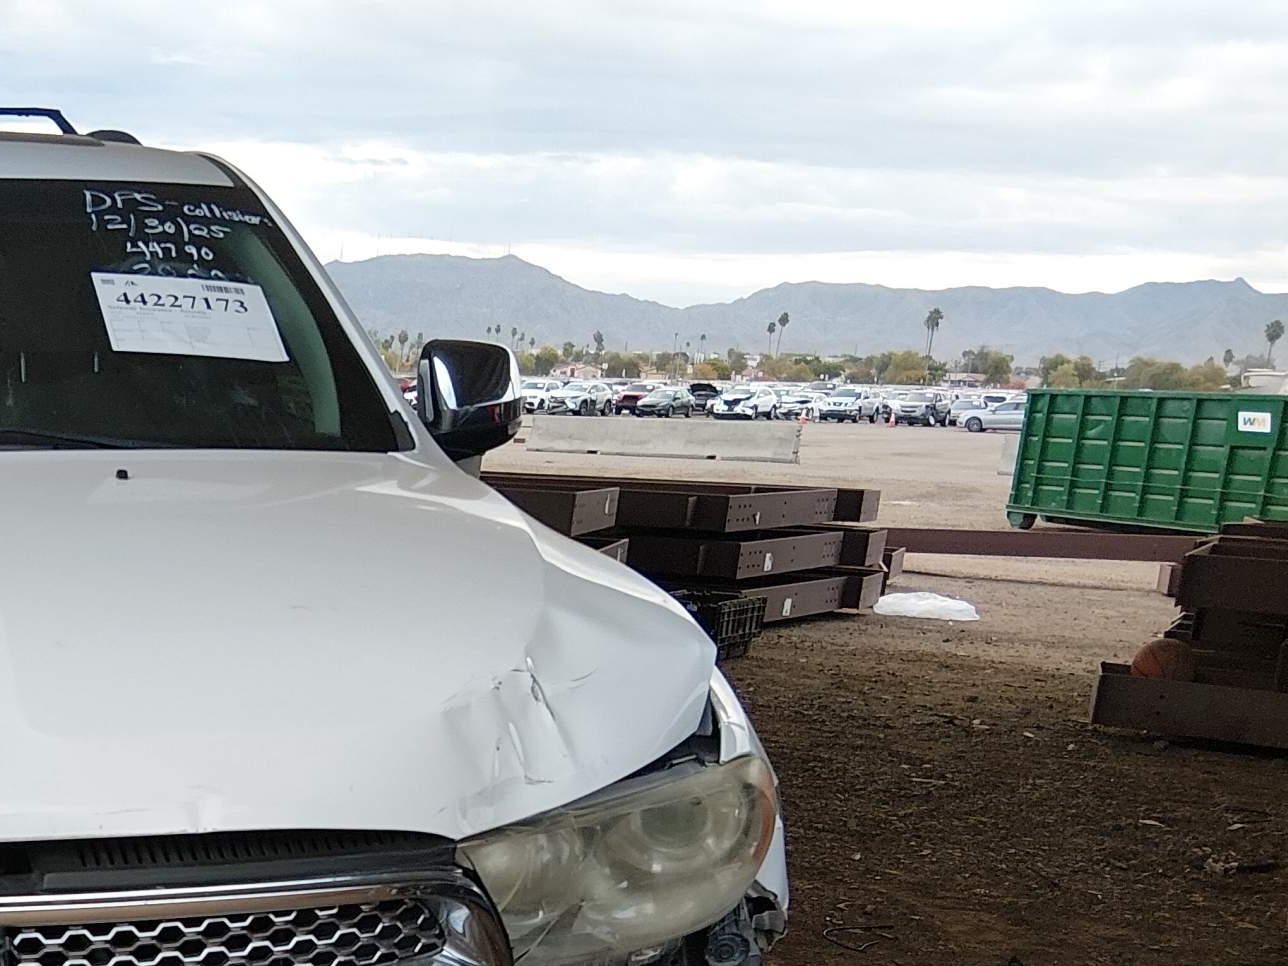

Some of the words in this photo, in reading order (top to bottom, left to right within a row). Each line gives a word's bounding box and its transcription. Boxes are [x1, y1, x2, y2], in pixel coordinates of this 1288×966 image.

[90, 212, 233, 242] 12/30/25
[116, 291, 249, 315] 44227173
[1242, 416, 1266, 428] WM
